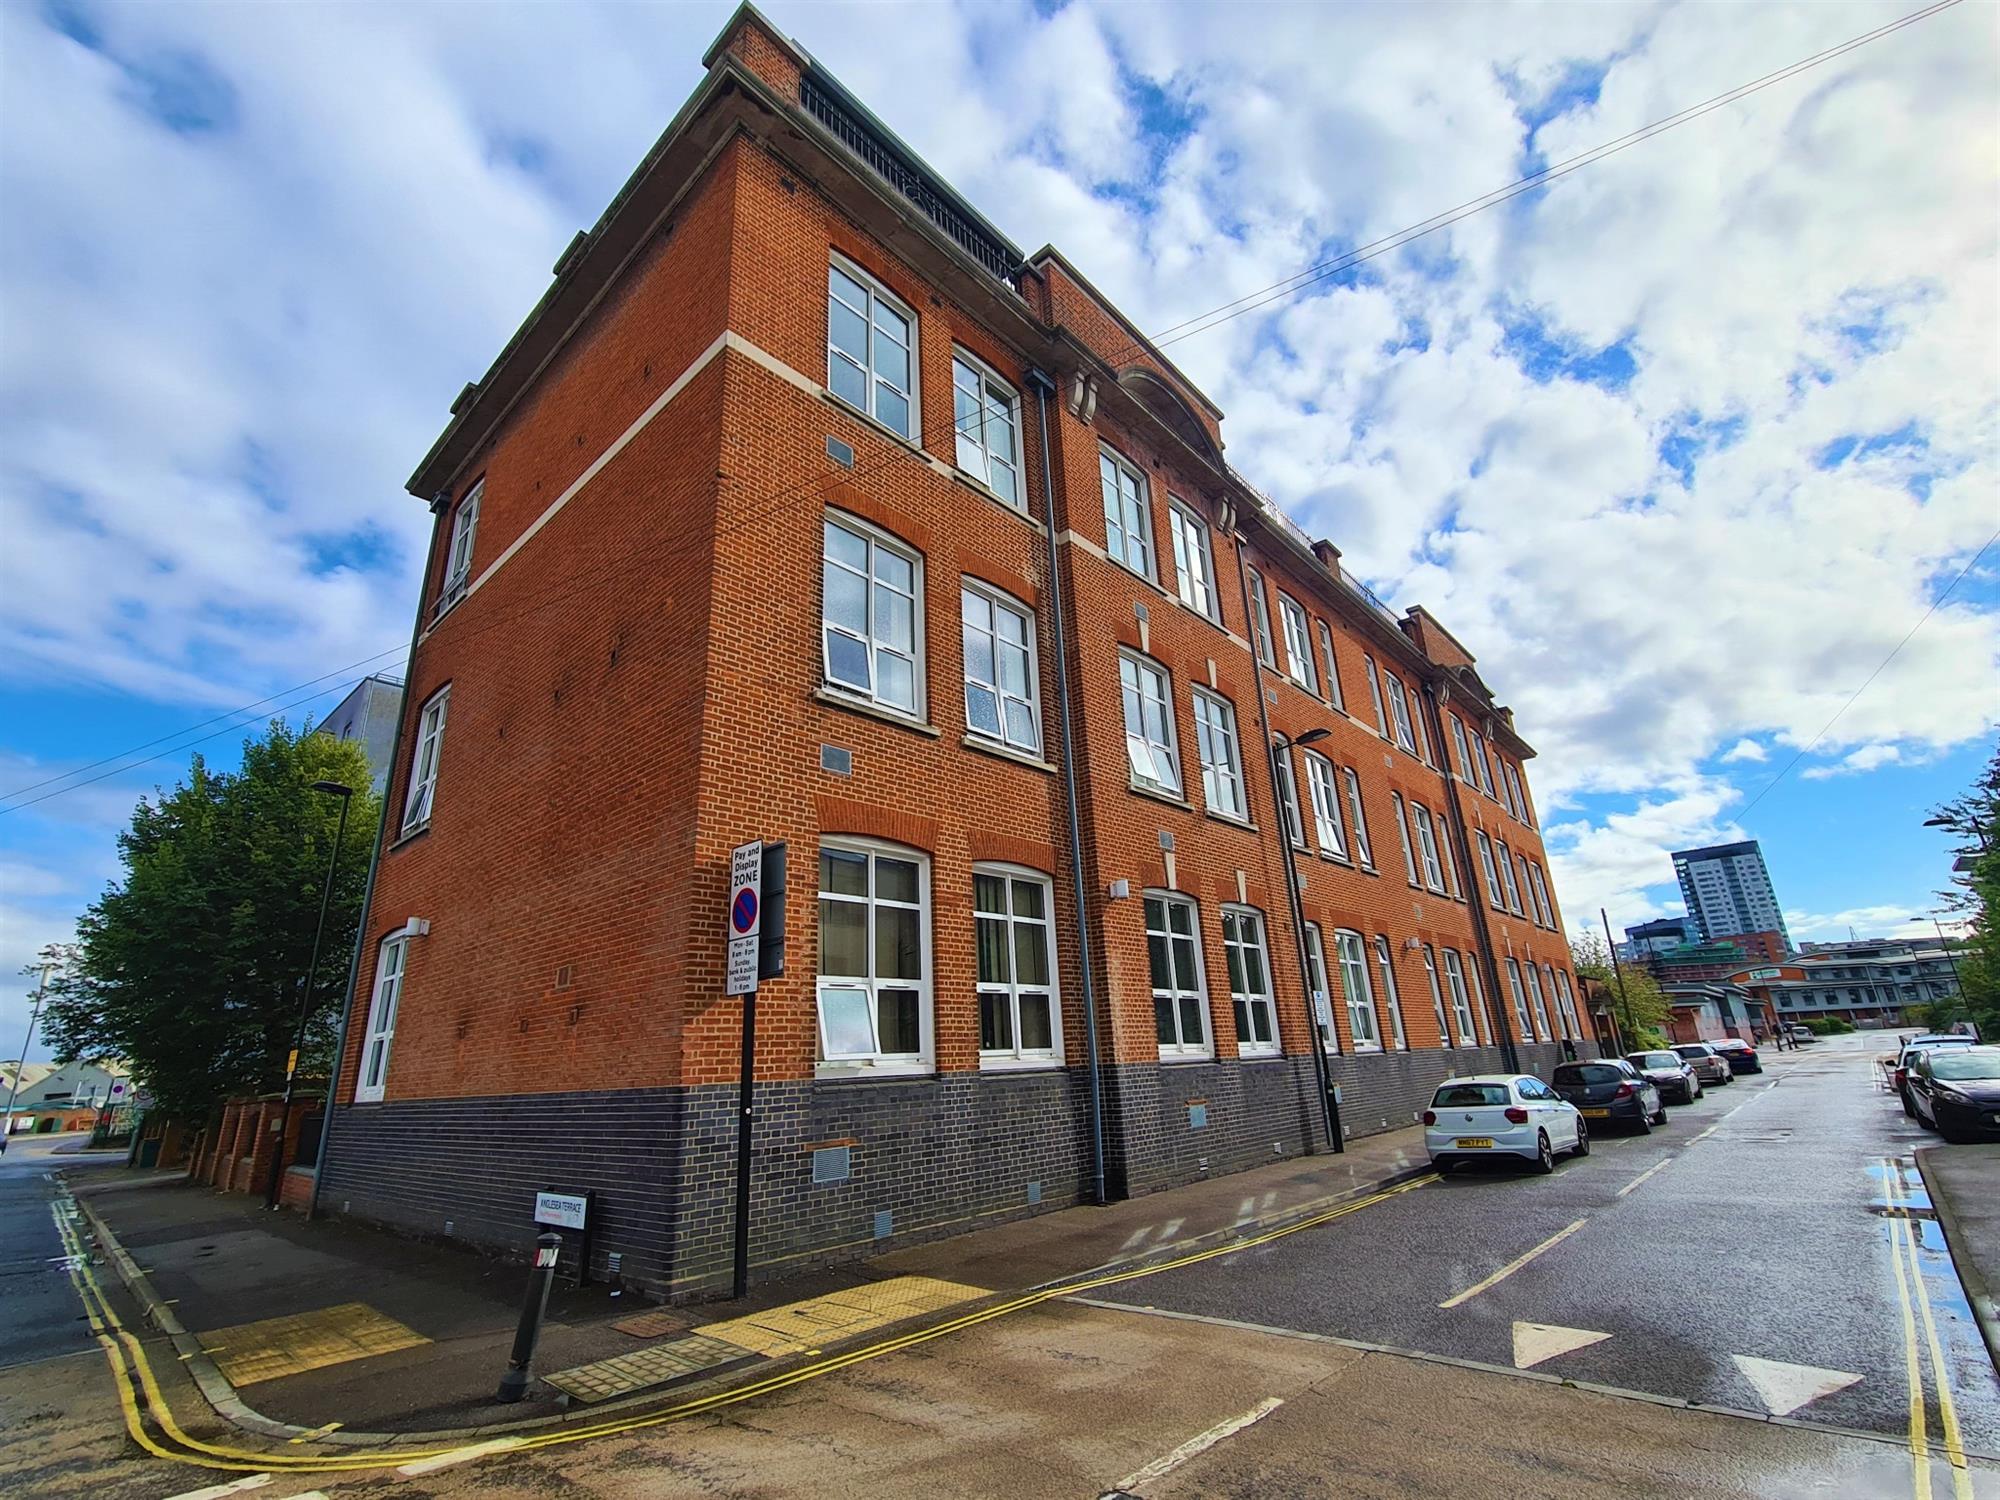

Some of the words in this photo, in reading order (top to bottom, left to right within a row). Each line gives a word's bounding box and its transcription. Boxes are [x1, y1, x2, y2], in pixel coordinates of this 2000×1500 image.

[735, 852, 746, 861] Pay
[747, 845, 760, 857] and
[735, 859, 758, 872] Display
[734, 870, 758, 887] ZONE
